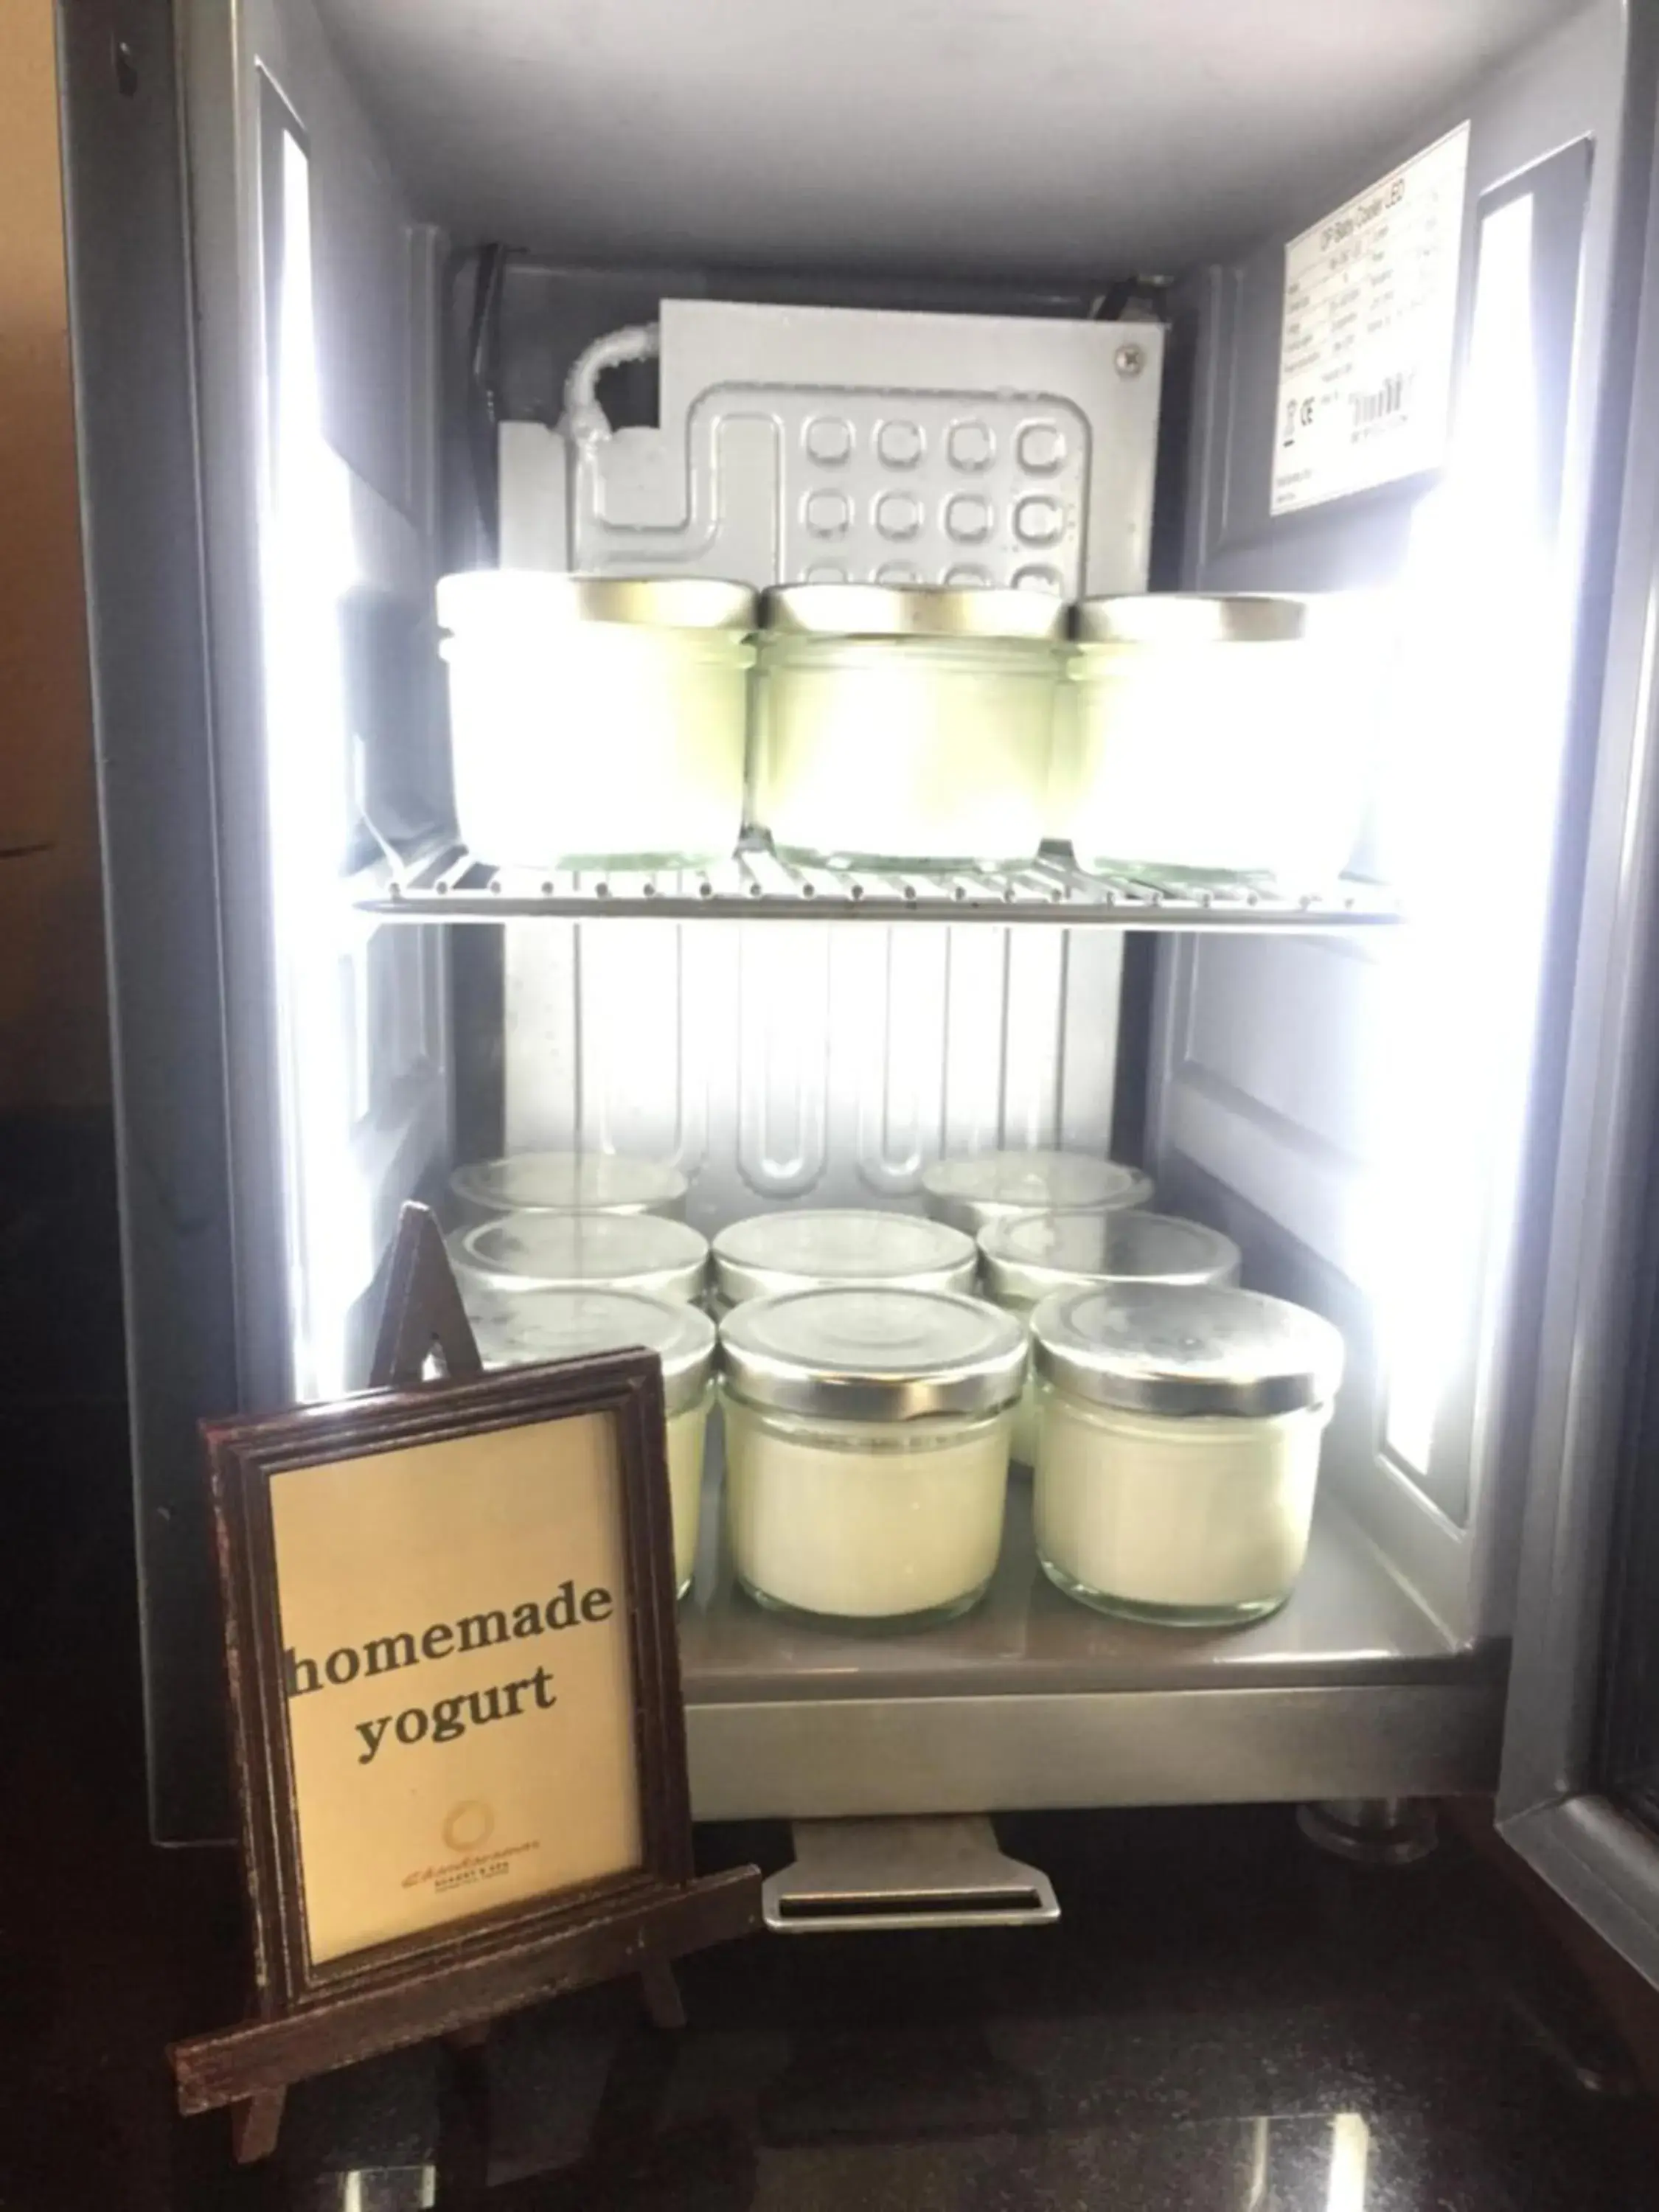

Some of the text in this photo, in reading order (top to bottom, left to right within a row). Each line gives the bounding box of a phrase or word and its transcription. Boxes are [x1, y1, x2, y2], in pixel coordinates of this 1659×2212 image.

[1384, 178, 1405, 209] LED
[1300, 396, 1315, 427] CE
[284, 1579, 613, 1698] homemade
[355, 1666, 557, 1764] yogurt
